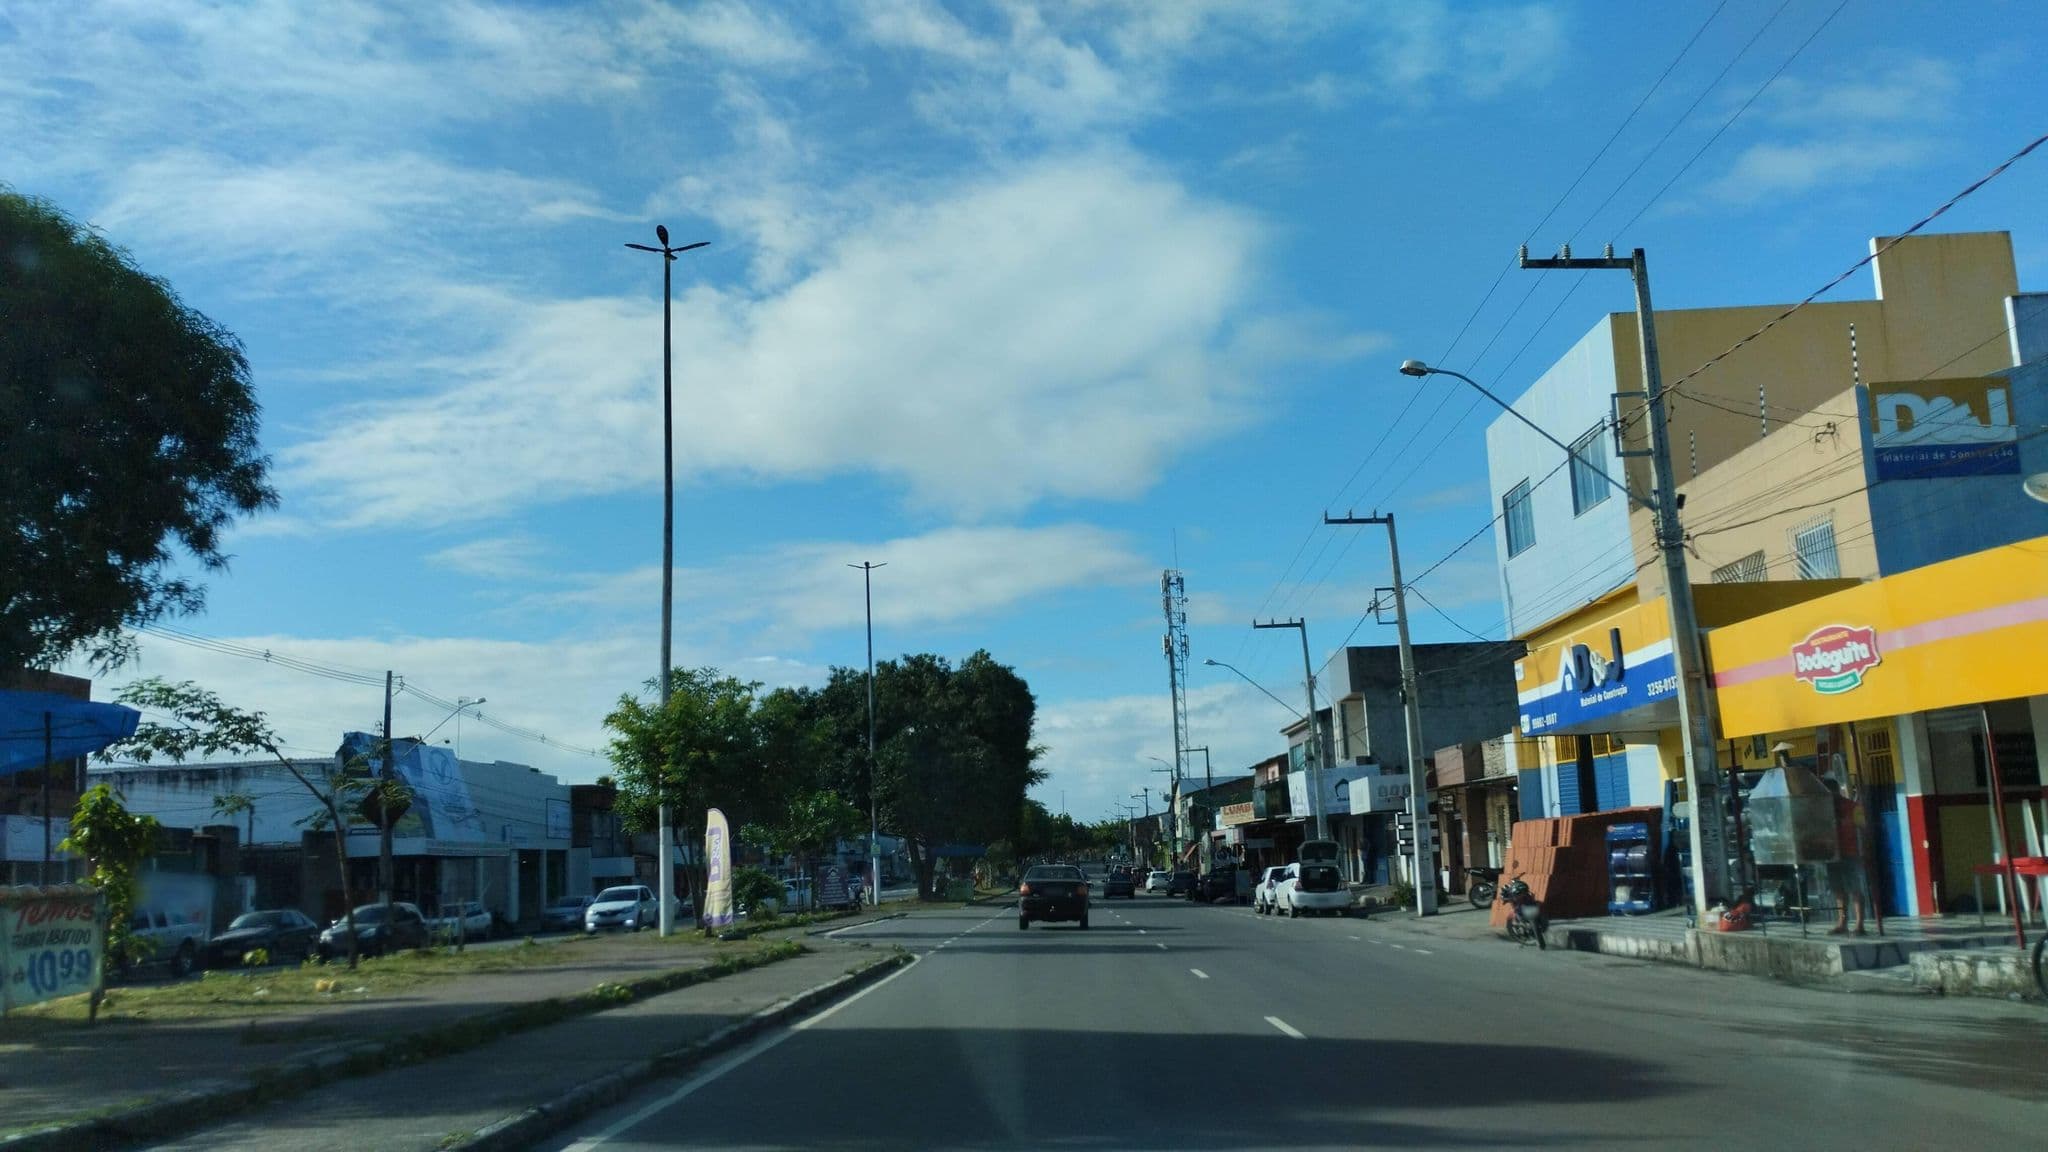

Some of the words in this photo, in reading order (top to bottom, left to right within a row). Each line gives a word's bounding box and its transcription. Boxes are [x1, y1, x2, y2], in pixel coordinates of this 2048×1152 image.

[1883, 452, 1929, 462] Material
[1933, 450, 1945, 460] de
[1796, 641, 1871, 673] Bodeguita
[1223, 803, 1254, 816] LUMB
